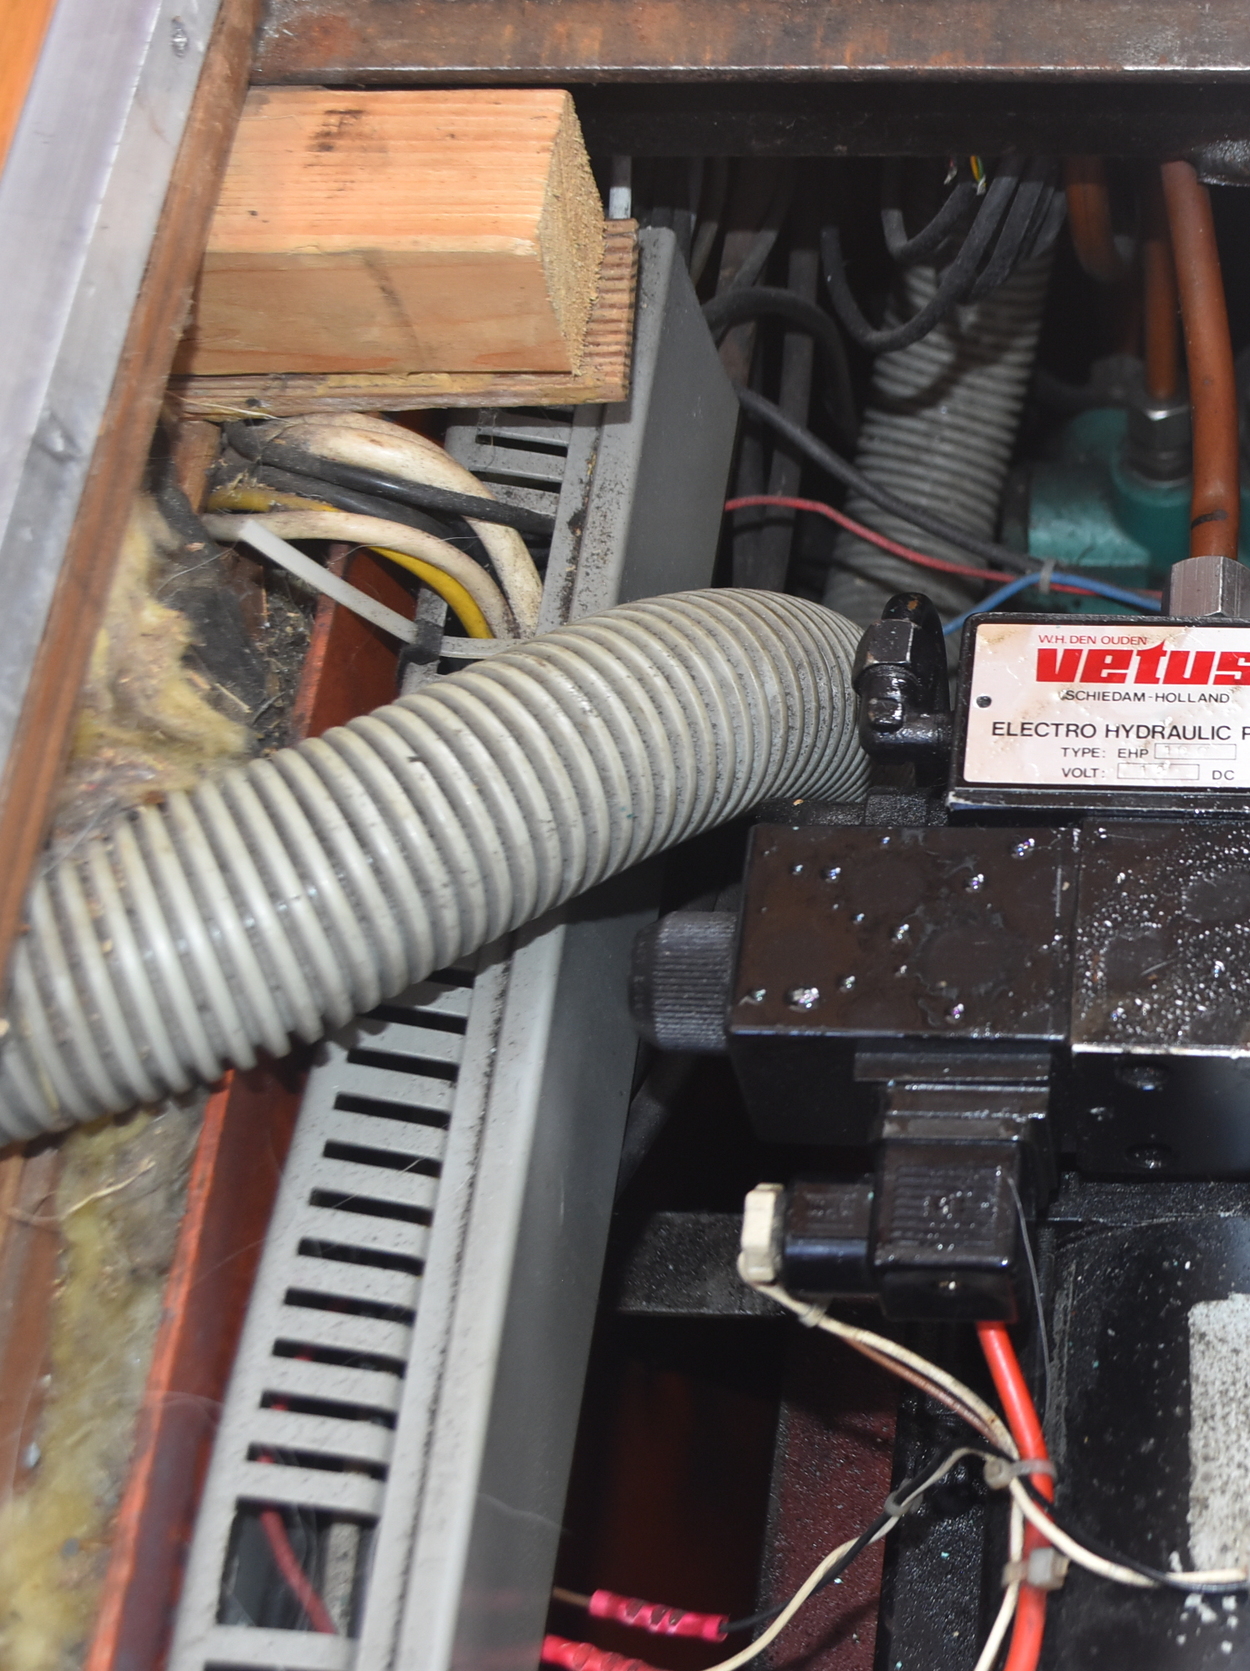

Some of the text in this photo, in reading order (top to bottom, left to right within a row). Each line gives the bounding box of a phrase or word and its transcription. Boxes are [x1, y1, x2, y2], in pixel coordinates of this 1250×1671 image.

[1070, 635, 1097, 645] DEN
[1101, 636, 1148, 646] OUDEN
[991, 721, 1097, 739] ELECTRO
[1105, 723, 1232, 741] HYDRAULIC
[1061, 747, 1149, 759] TYPE: EHP
[1061, 768, 1105, 779] VOLT:
[1211, 769, 1235, 781] DC
